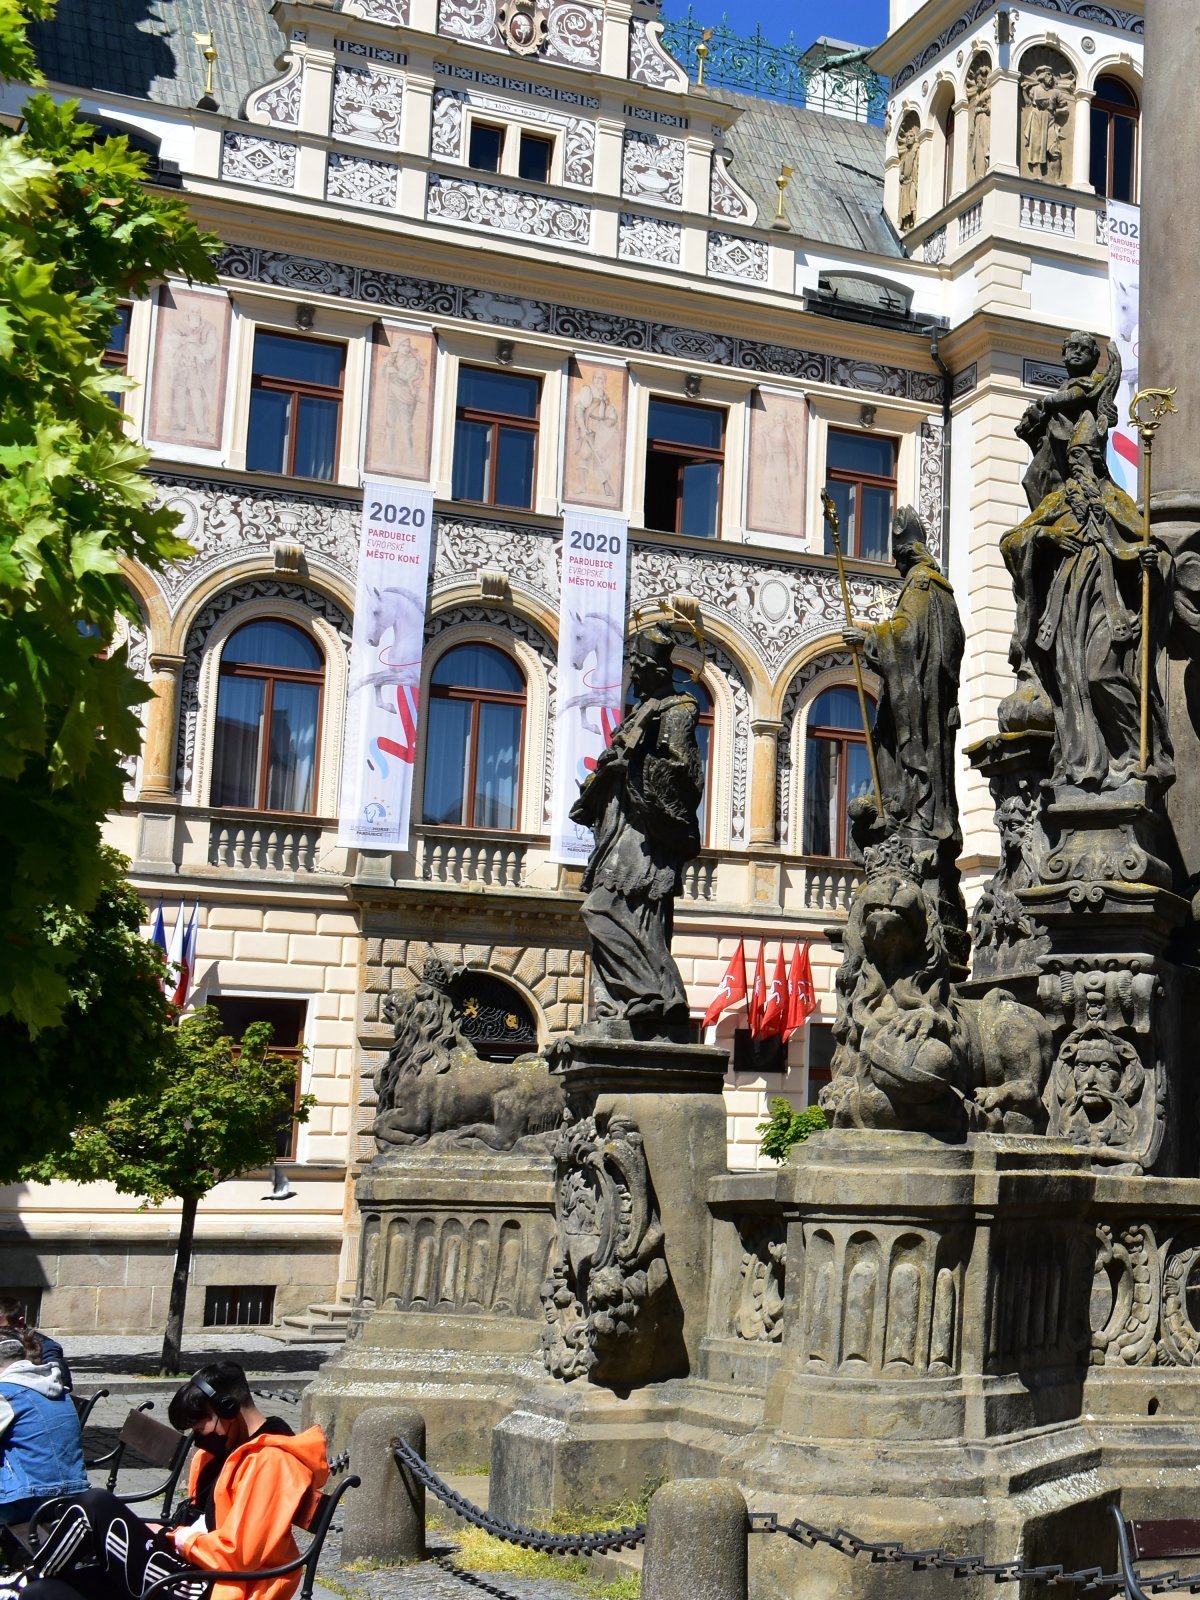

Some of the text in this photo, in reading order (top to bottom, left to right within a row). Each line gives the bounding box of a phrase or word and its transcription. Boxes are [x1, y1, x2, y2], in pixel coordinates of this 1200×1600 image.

[1109, 217, 1139, 239] 202
[1109, 235, 1140, 249] PARDUBIC
[1110, 251, 1131, 263] MĚSTO
[369, 501, 426, 527] 2020
[368, 528, 417, 542] PARDUBICE
[366, 539, 405, 551] EVROPSKÉ
[570, 530, 621, 555] 2020
[366, 549, 420, 565] MĚSTO KONÍ
[569, 556, 614, 569] PARDUBICE
[568, 566, 604, 578] EVROPSKÉ
[568, 576, 617, 590] MĚSTO KONÍ
